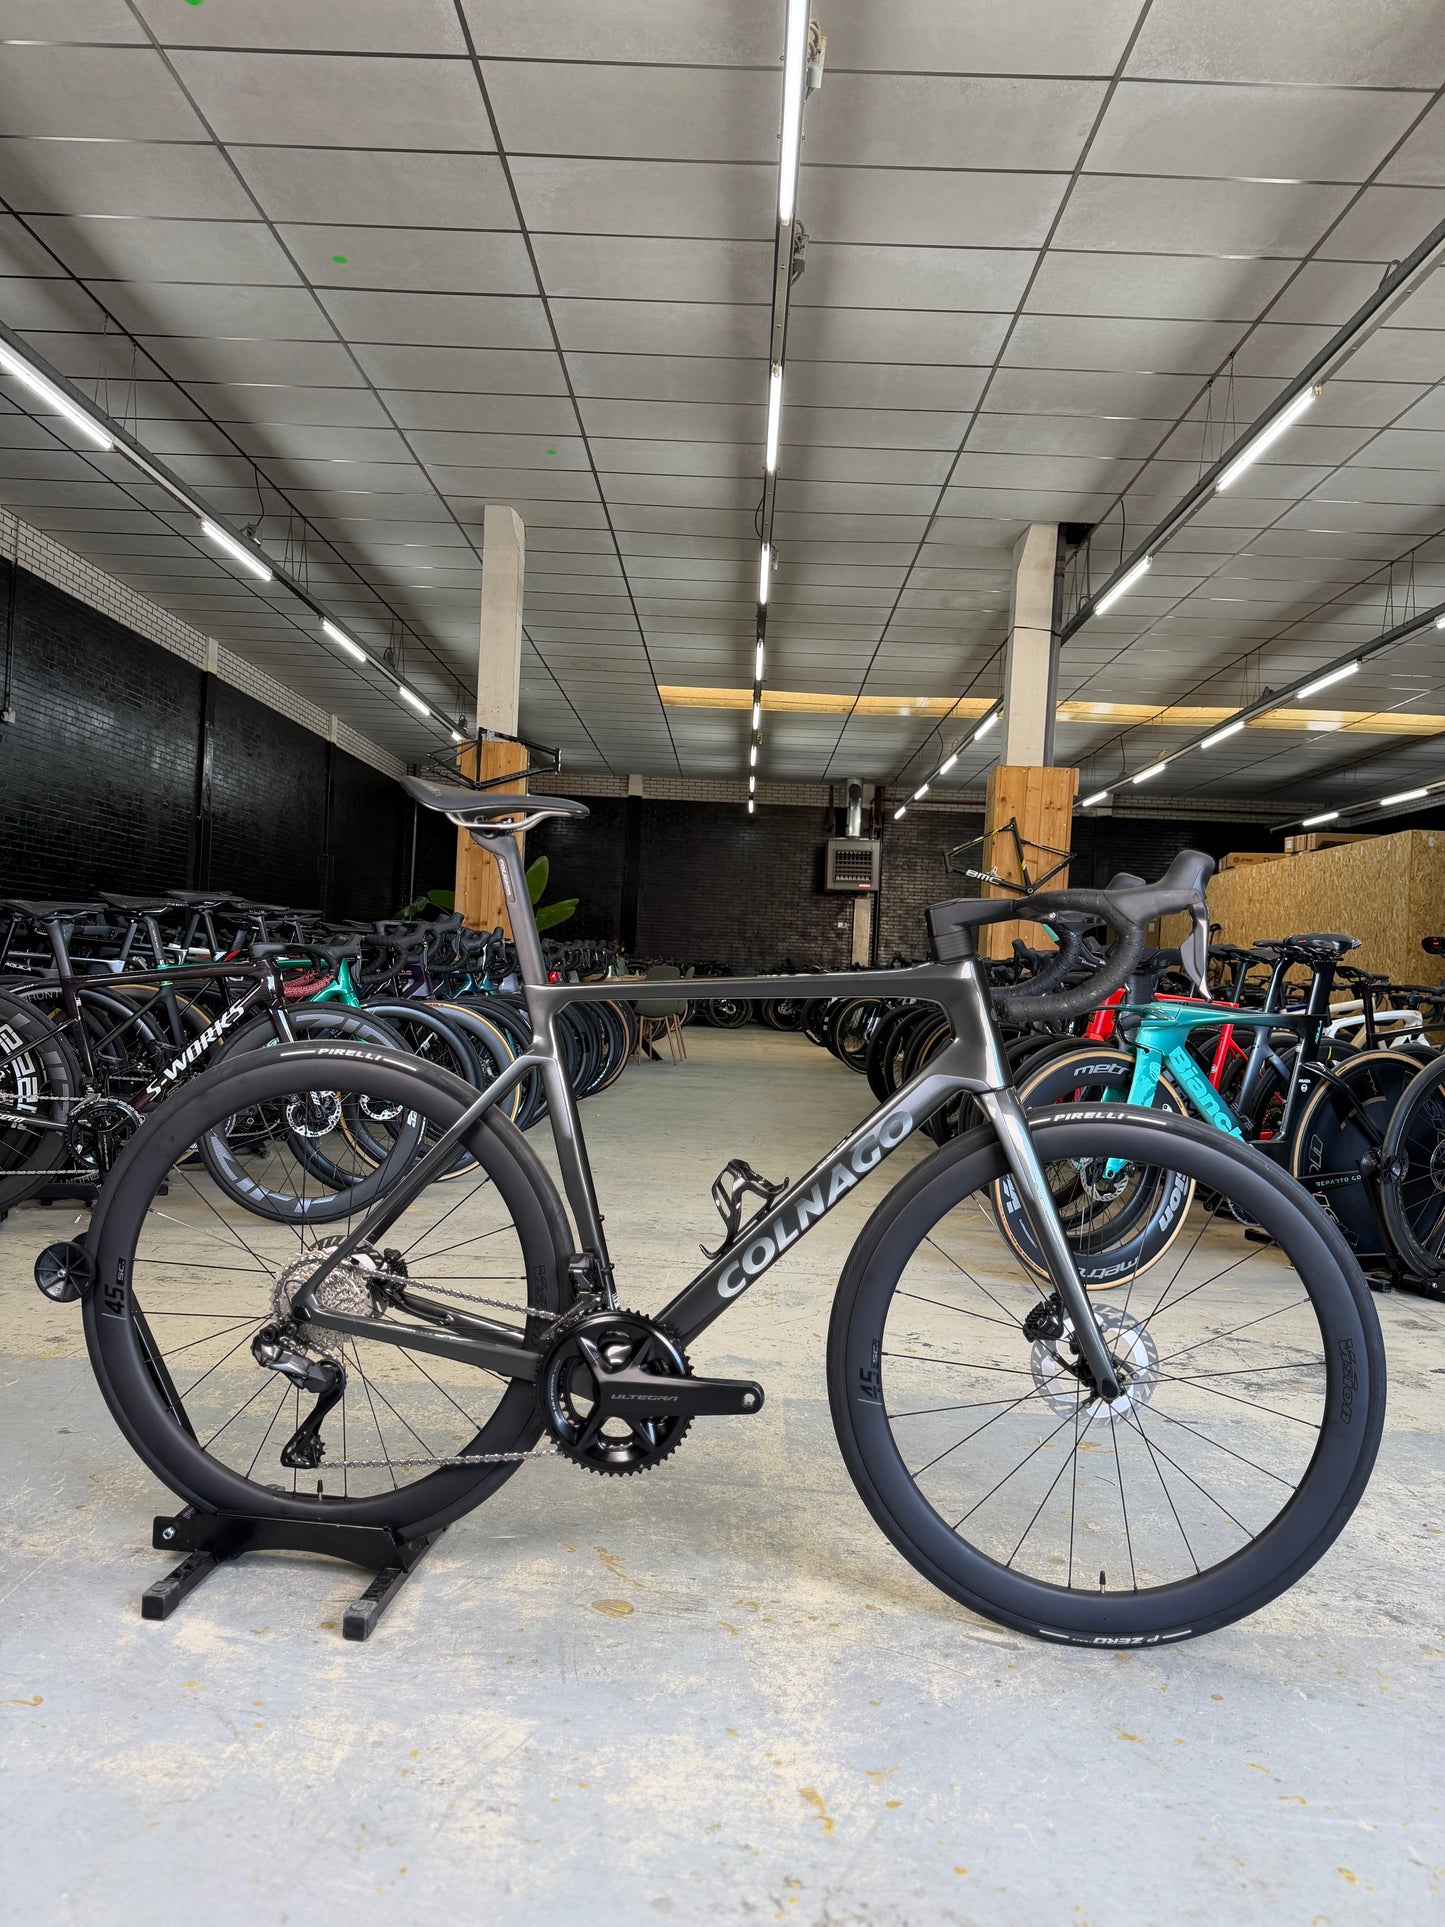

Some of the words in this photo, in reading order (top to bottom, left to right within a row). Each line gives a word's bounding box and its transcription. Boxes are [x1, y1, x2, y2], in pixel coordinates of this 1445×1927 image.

[499, 858, 512, 896] COLNAGO
[965, 869, 1001, 885] BMC
[146, 999, 245, 1102] S-WORKS
[318, 1048, 382, 1061] PIRELLI
[1073, 1063, 1131, 1077] metr
[1054, 1112, 1124, 1122] PIRELLI
[717, 1110, 914, 1298] COLNAGO
[105, 1284, 125, 1314] 45
[859, 1367, 880, 1399] 45
[1338, 1338, 1358, 1424] Vision
[1093, 1637, 1144, 1645] ZERO
[1146, 1635, 1160, 1643] P
